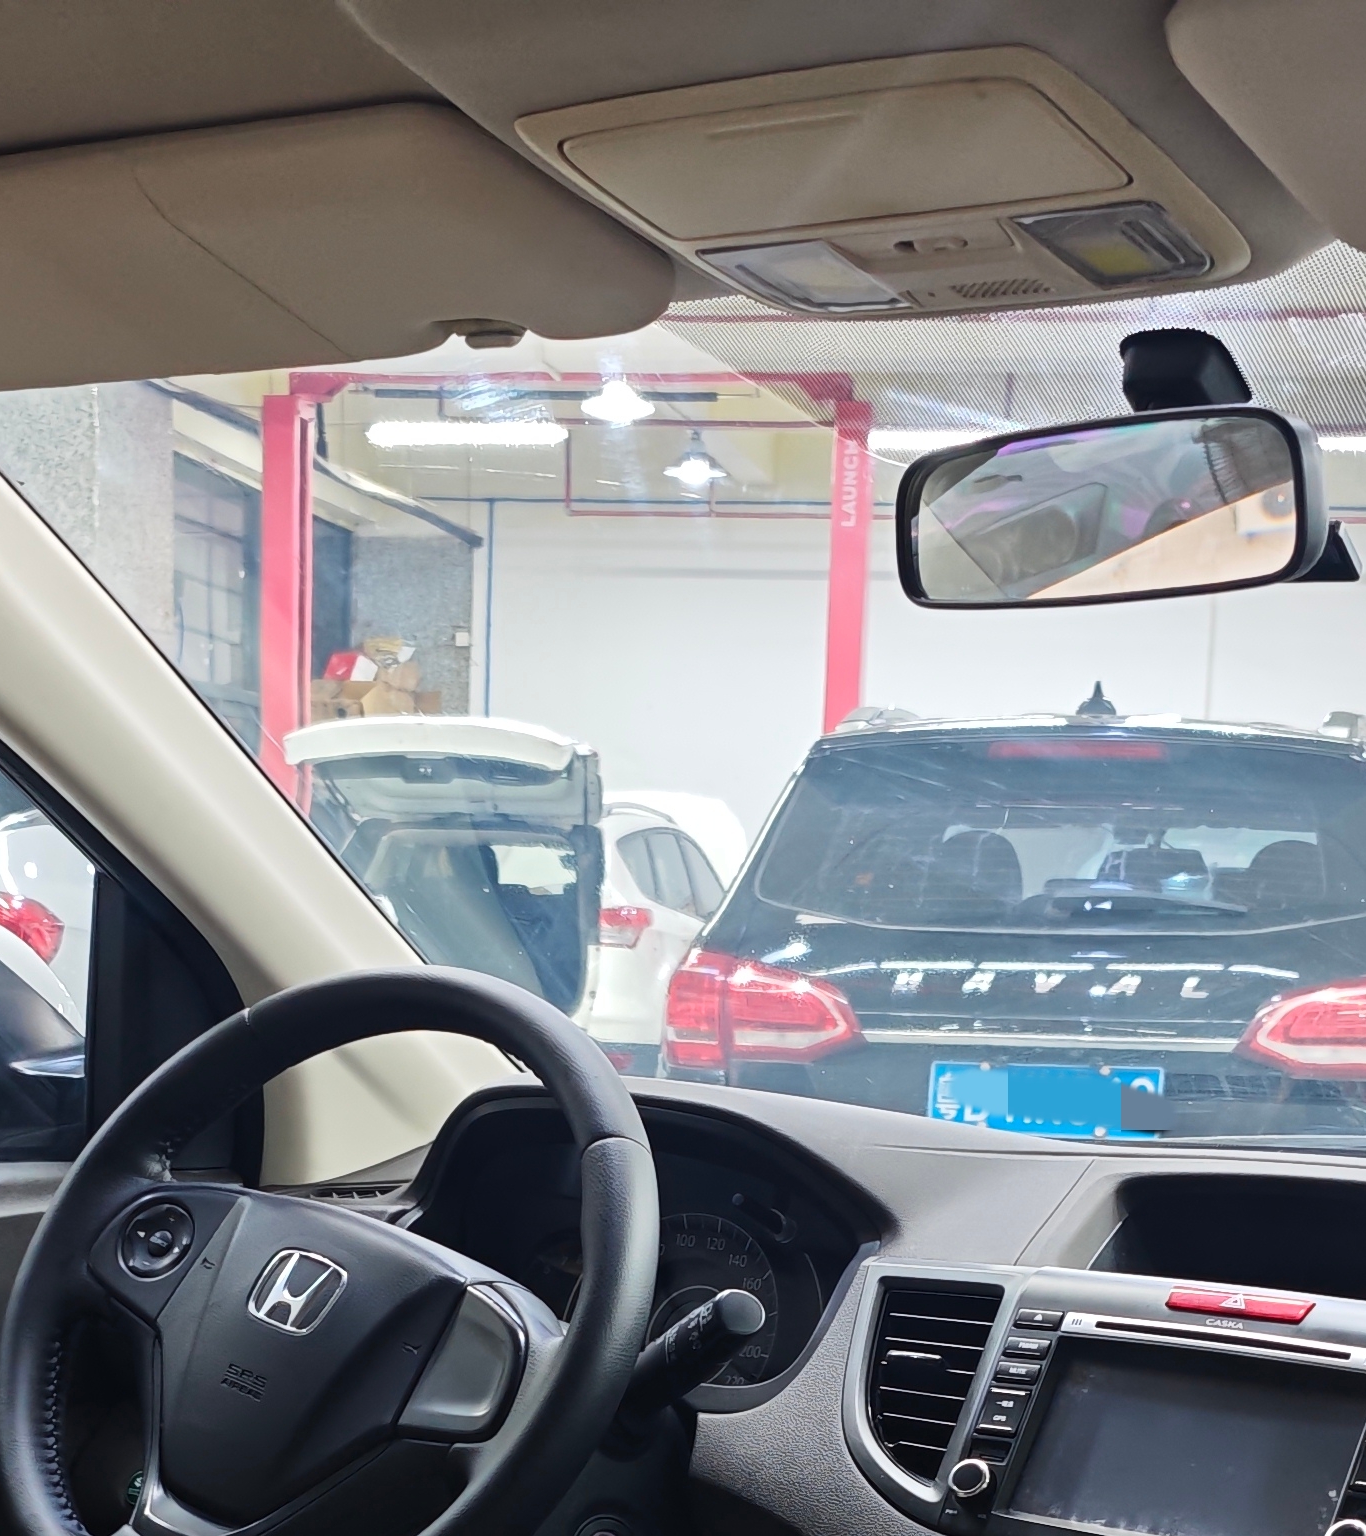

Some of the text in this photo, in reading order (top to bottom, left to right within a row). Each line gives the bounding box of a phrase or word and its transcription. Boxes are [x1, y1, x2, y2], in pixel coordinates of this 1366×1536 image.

[891, 970, 1210, 999] HAVAL
[675, 1233, 696, 1248] 100
[706, 1237, 726, 1251] 120
[728, 1254, 748, 1268] 140
[742, 1277, 763, 1291] 160
[1205, 1318, 1244, 1330] CASKA
